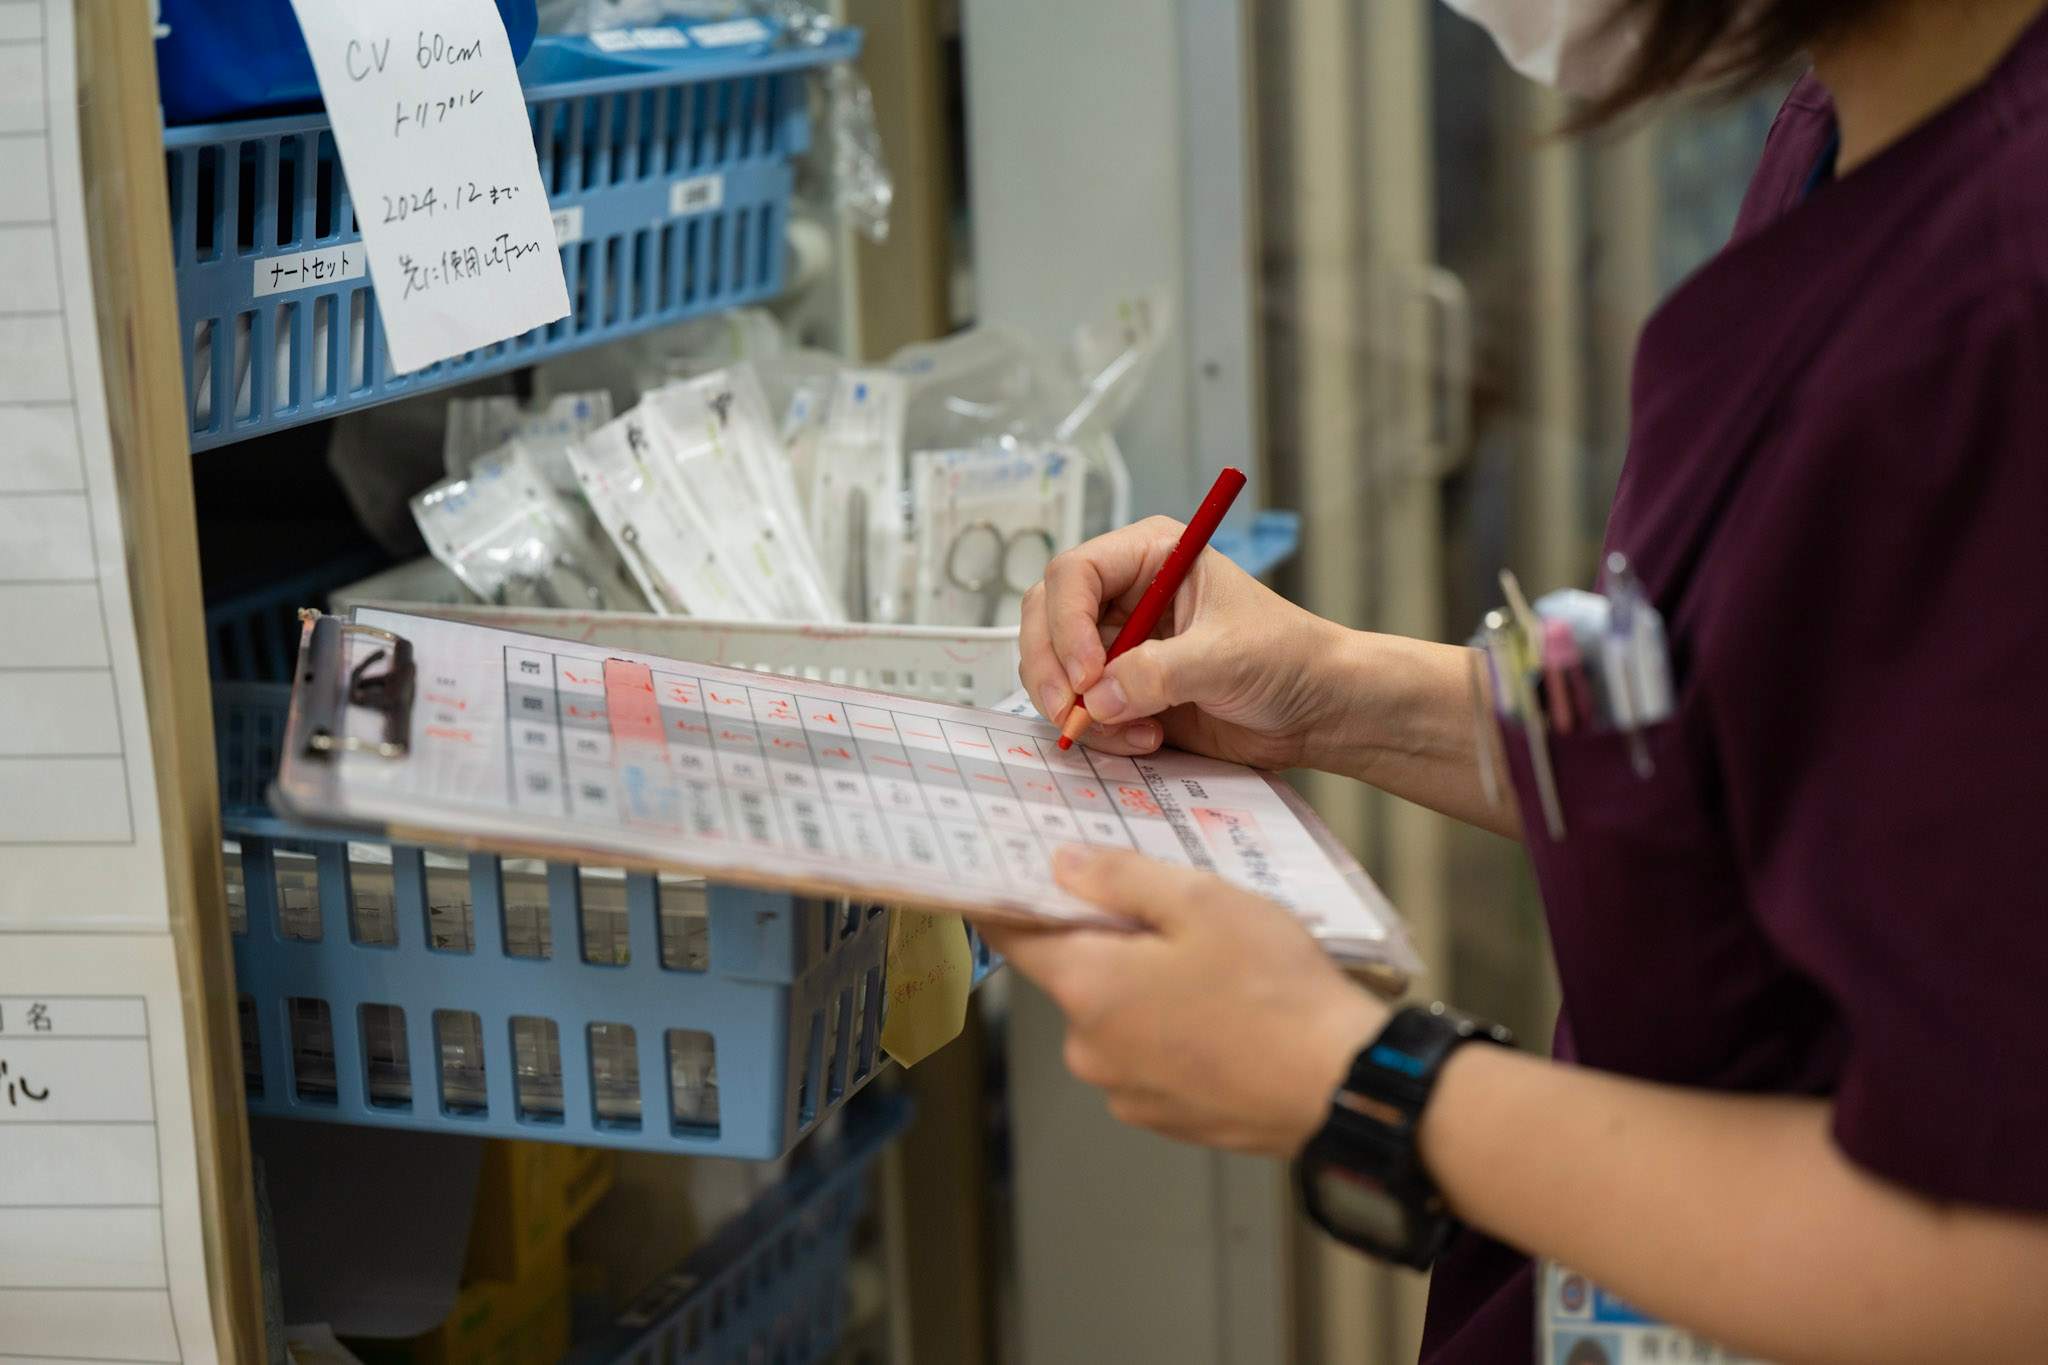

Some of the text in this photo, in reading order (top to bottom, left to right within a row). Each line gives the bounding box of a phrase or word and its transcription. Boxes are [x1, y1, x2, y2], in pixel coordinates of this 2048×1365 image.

[346, 31, 483, 82] CV 60cm
[394, 89, 484, 138] トリプル
[270, 250, 350, 288] ナートセット
